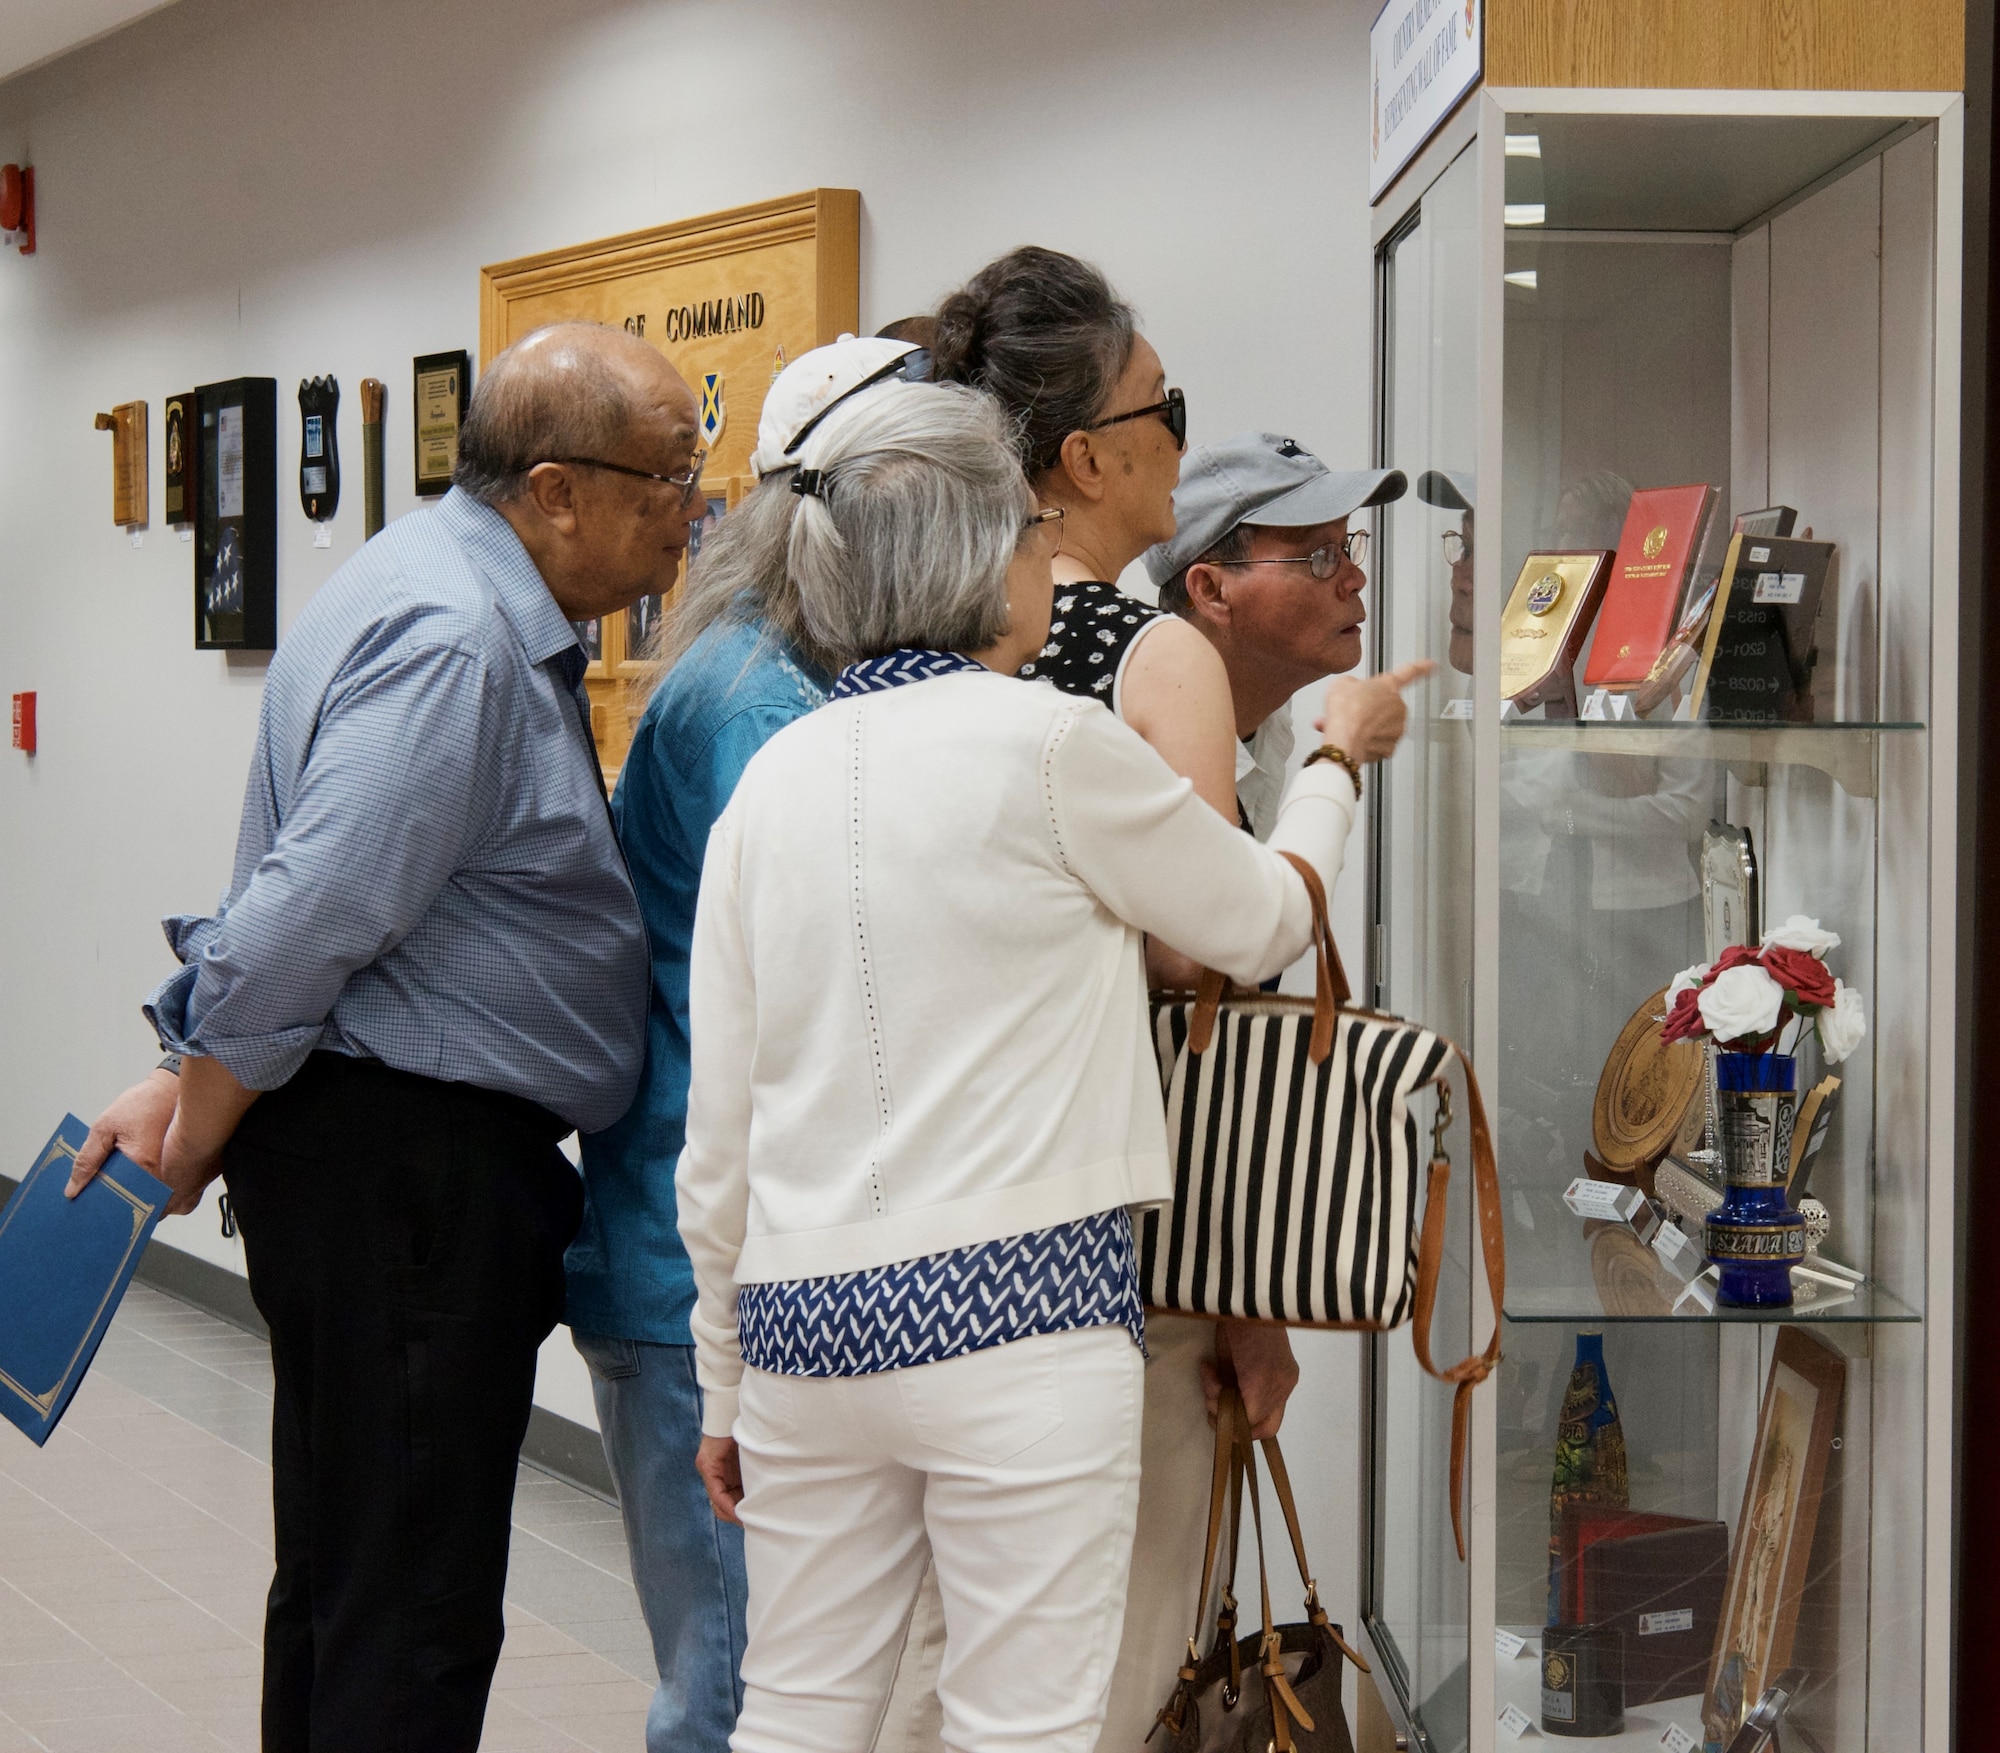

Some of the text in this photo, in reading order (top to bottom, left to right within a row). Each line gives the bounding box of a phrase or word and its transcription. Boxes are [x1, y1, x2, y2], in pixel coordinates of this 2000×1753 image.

[1393, 5, 1415, 69] COUNTRY
[1384, 11, 1458, 143] REPRESENTING WALL OF FAME
[624, 291, 765, 343] OF COMMAND
